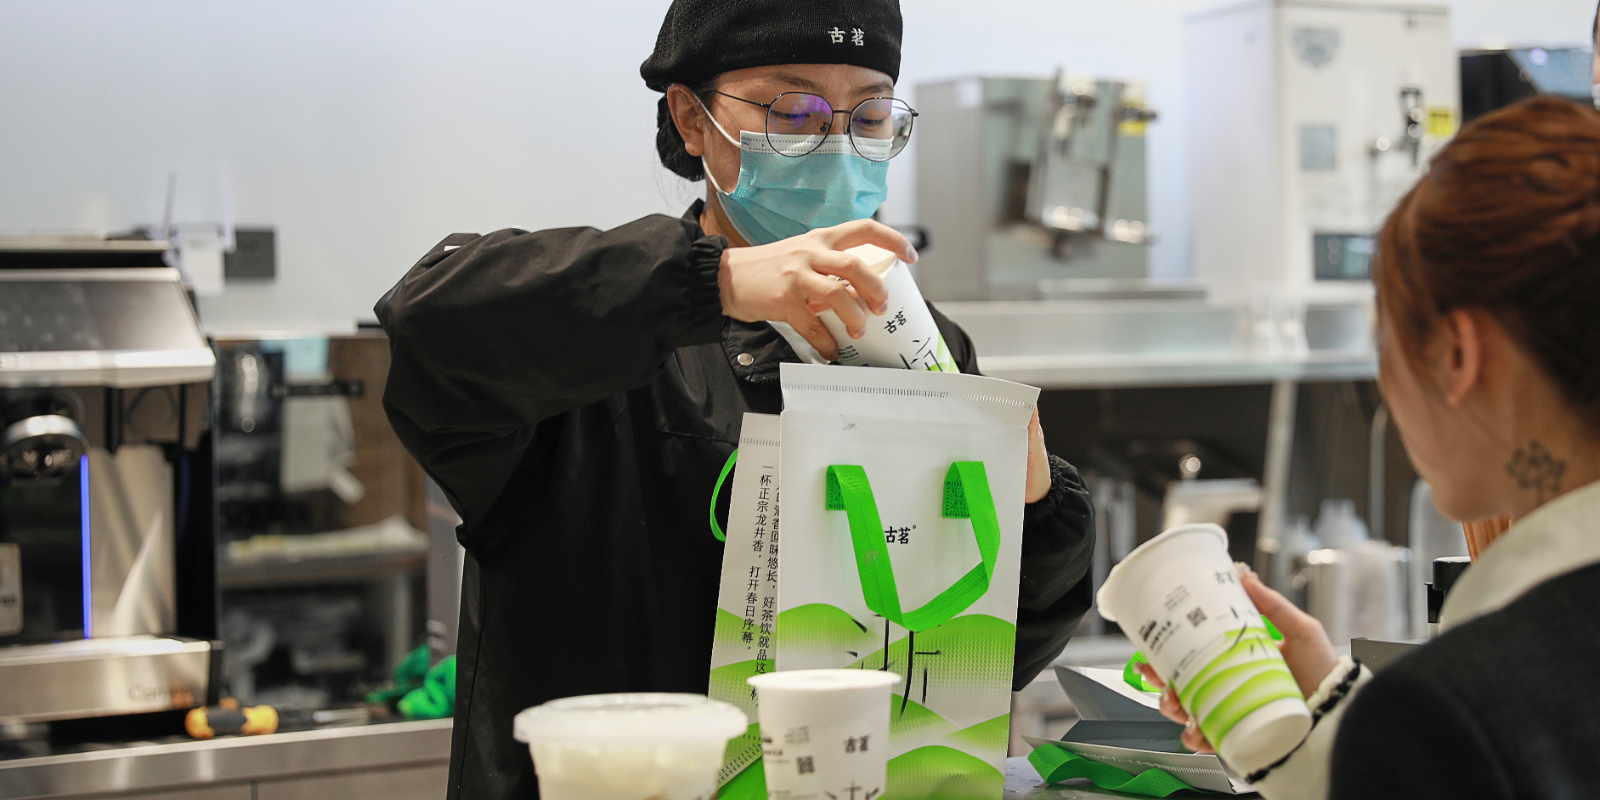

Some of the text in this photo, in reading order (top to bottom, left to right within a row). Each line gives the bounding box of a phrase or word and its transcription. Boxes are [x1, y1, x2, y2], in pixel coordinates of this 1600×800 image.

[828, 27, 864, 46] 古茗
[883, 310, 907, 334] 古茗
[884, 526, 911, 544] 古茗
